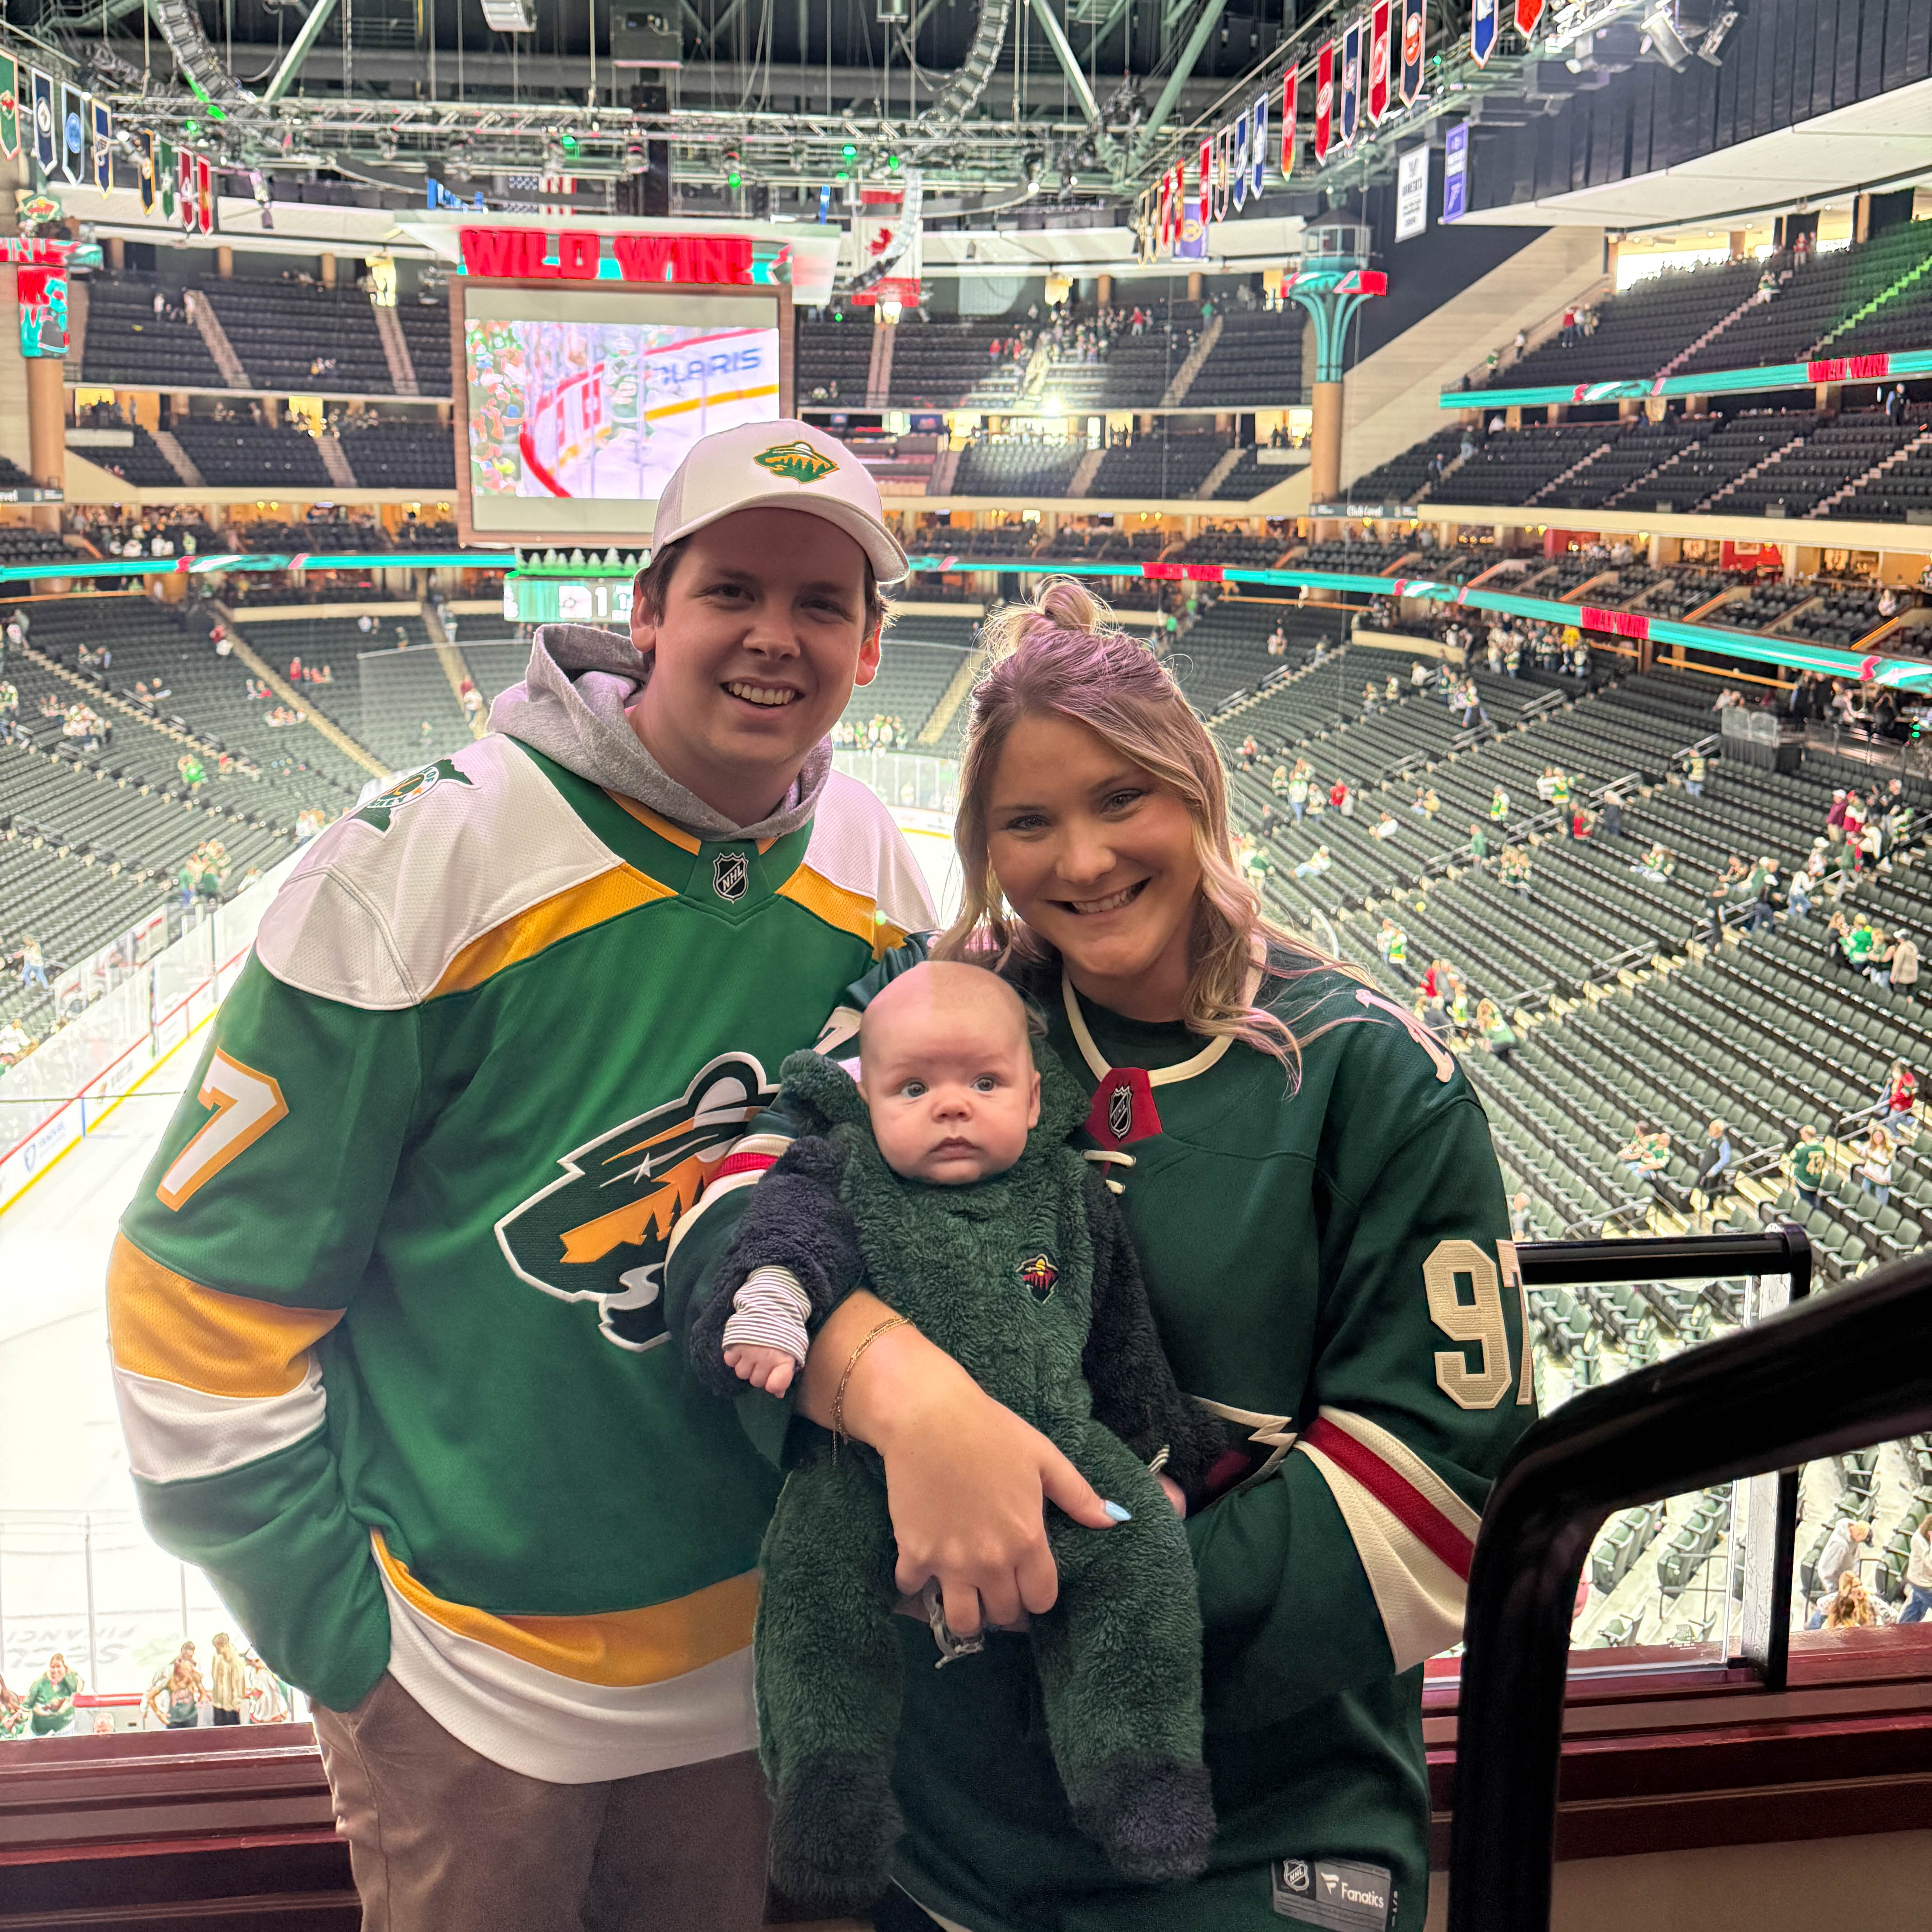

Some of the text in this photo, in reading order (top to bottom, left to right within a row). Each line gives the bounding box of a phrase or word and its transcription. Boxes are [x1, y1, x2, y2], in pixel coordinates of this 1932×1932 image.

[460, 229, 754, 285] WILD WIN!
[722, 865, 743, 892] NHL
[1113, 1100, 1126, 1124] NHL
[156, 1046, 290, 1212] 7
[1422, 1239, 1533, 1410] 97
[1289, 1866, 1305, 1883] NHL
[1341, 1882, 1385, 1909] Fanatics
